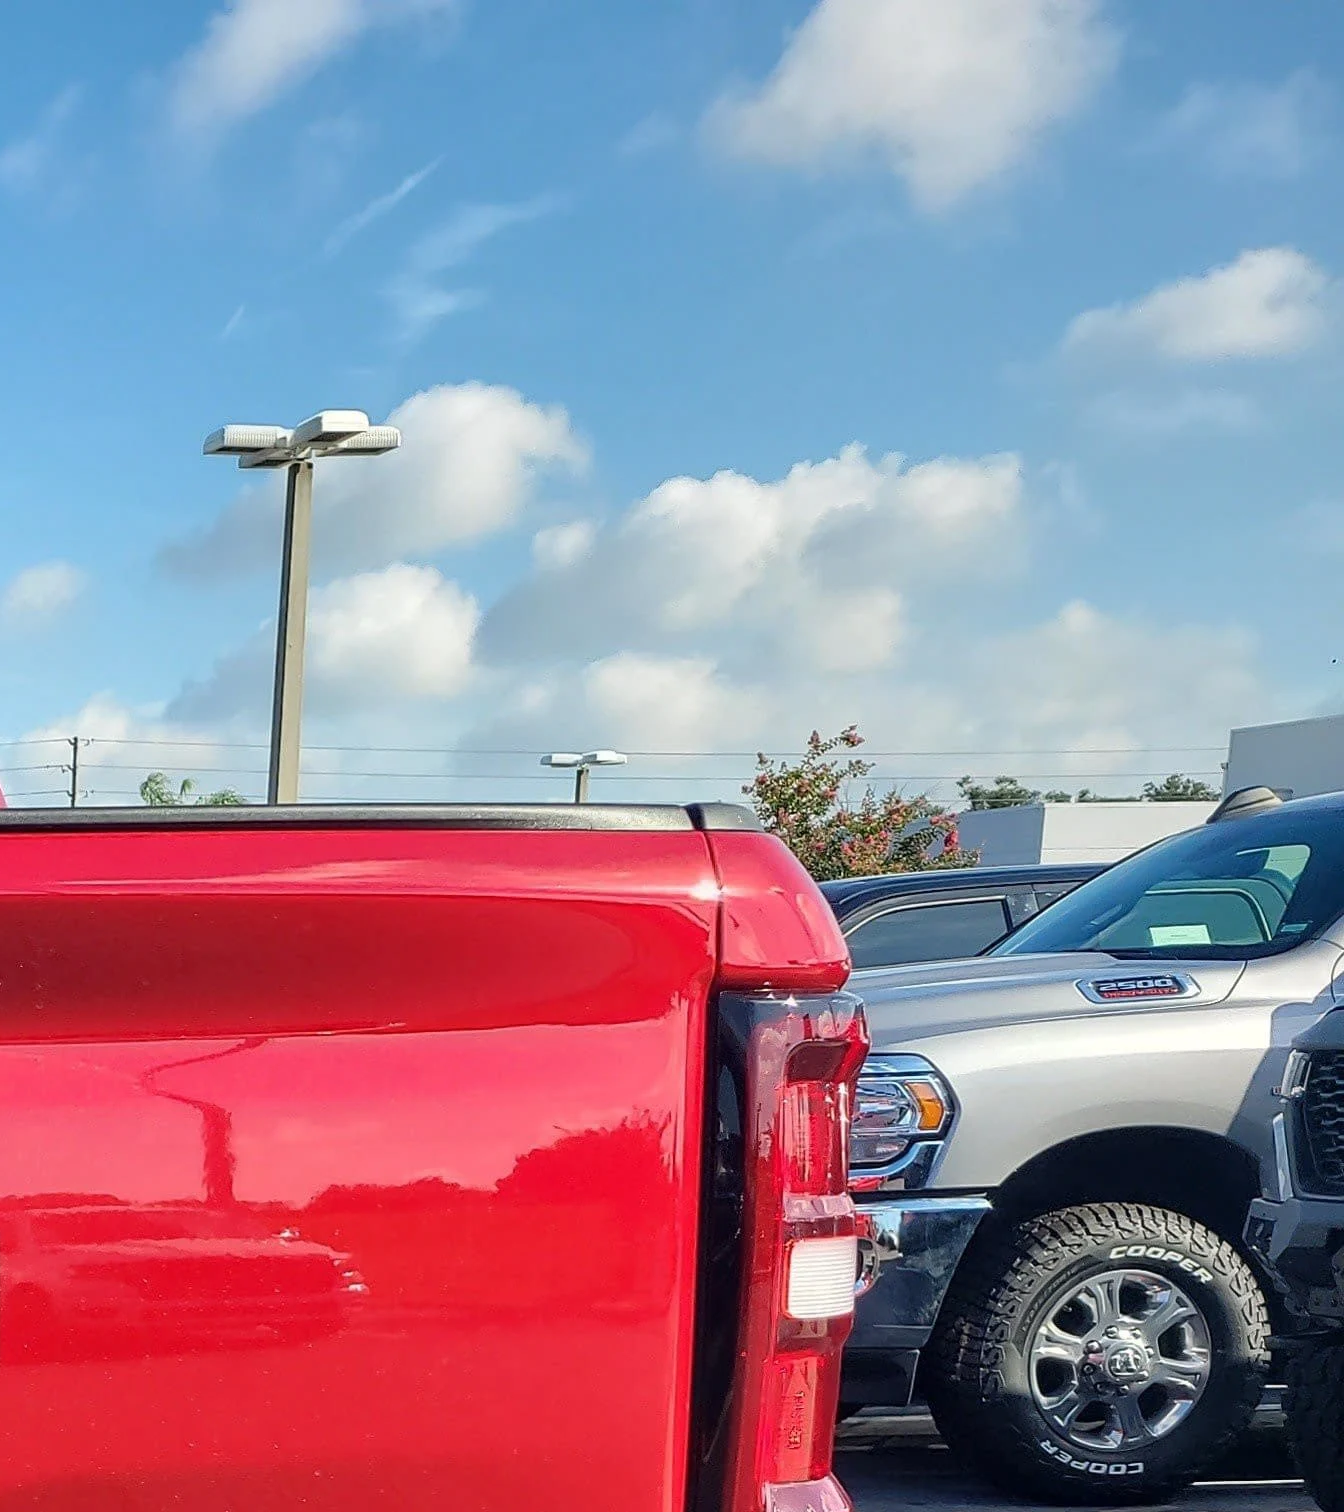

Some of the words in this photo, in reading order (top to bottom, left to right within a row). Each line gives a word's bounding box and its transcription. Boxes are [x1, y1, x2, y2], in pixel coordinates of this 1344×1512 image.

[1099, 978, 1173, 991] 2500
[1109, 1245, 1213, 1284] COOPER
[1040, 1440, 1144, 1475] COOPER
